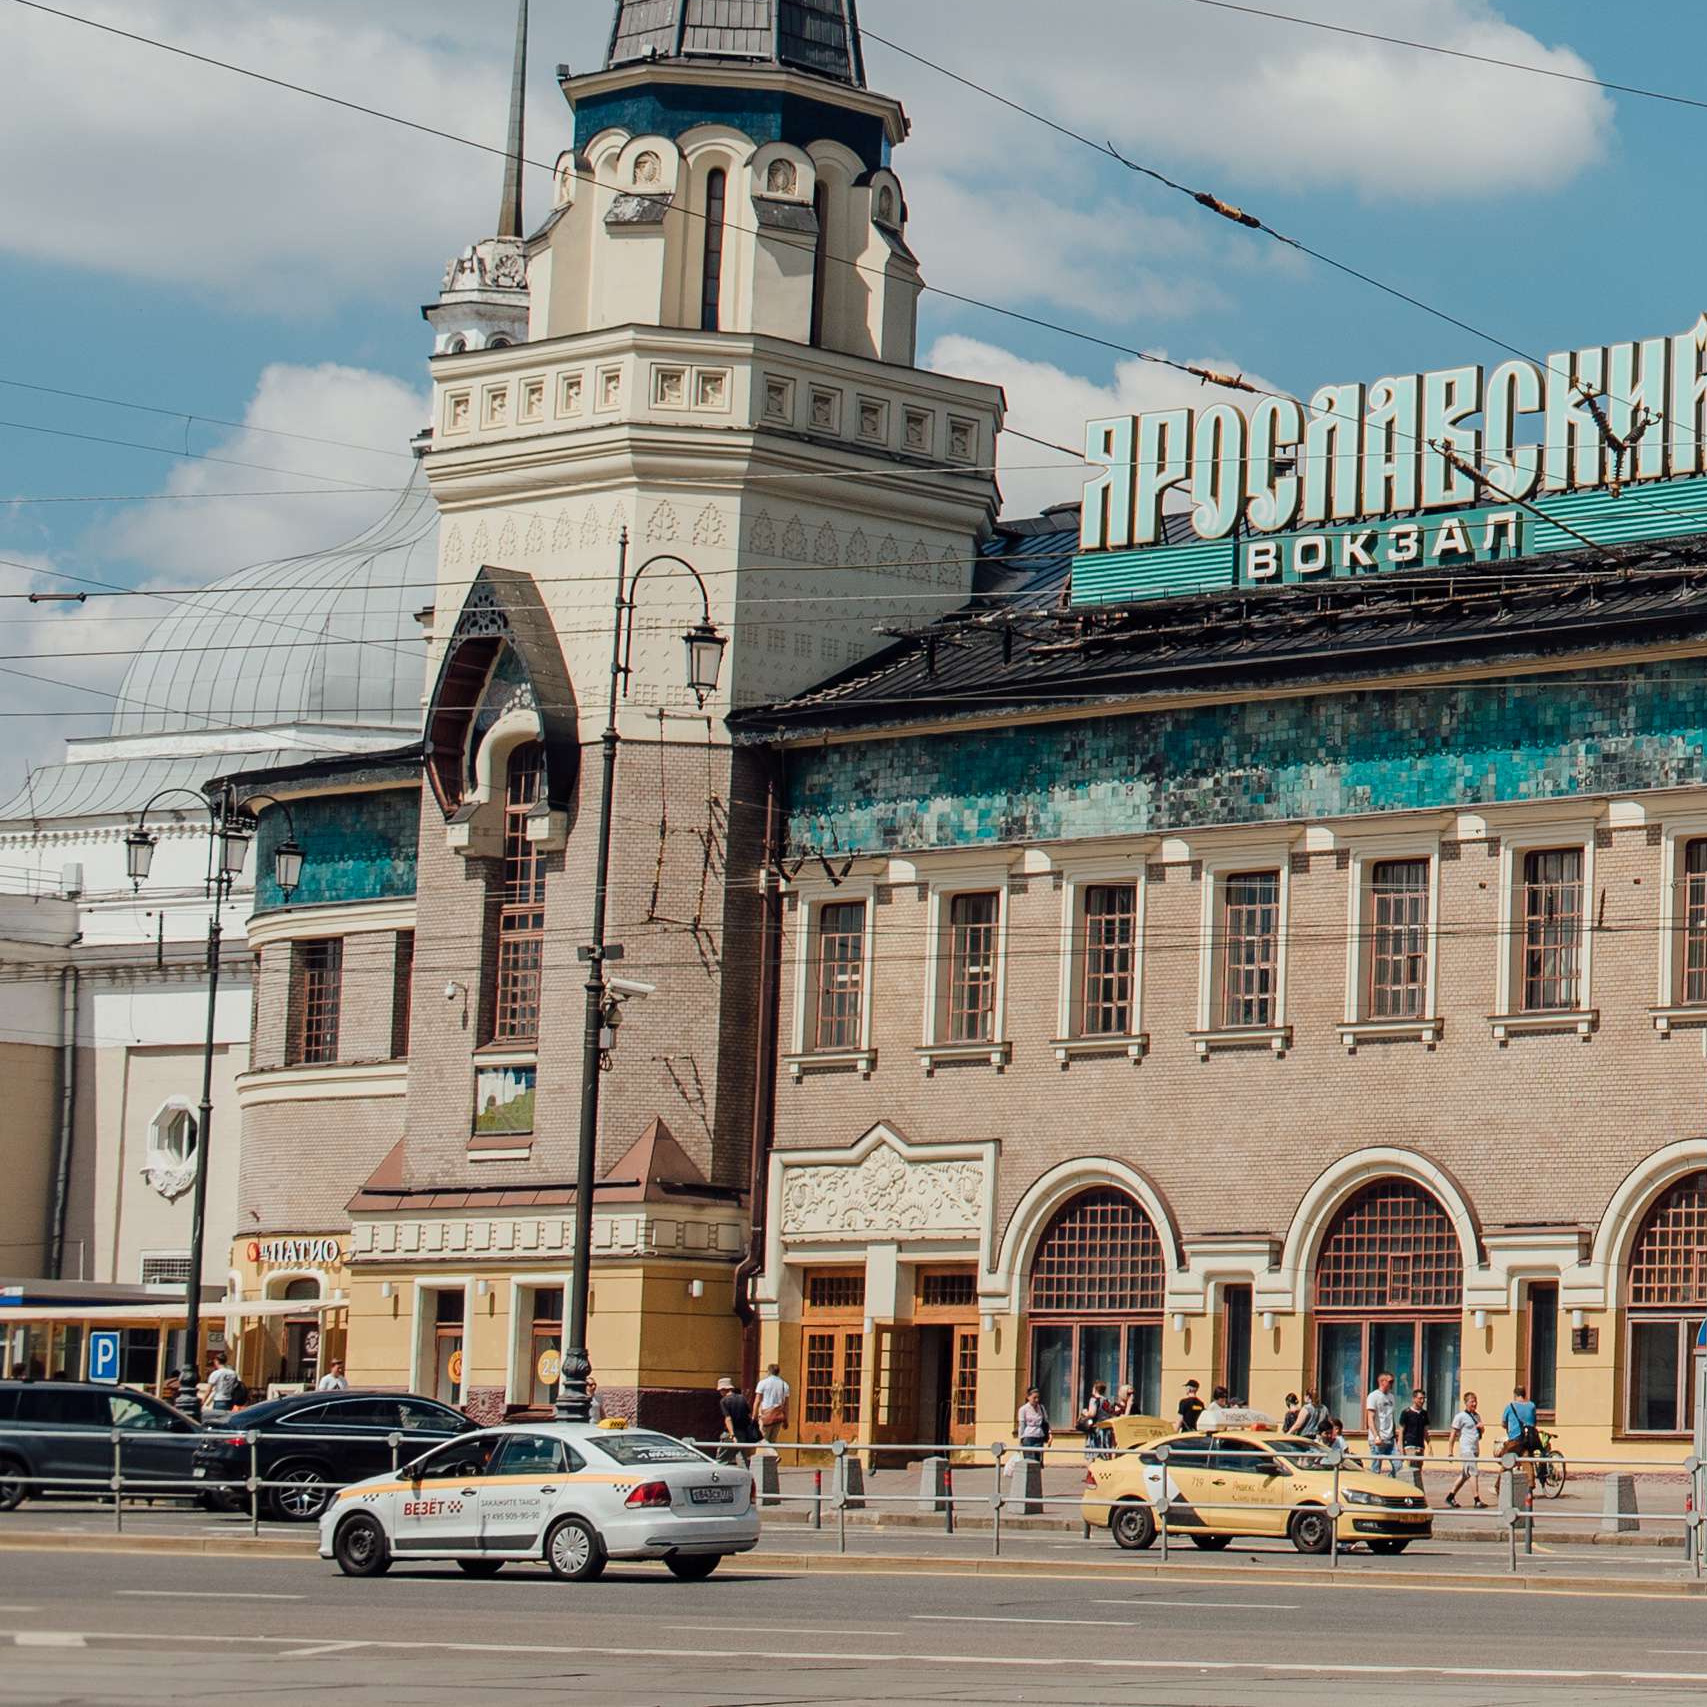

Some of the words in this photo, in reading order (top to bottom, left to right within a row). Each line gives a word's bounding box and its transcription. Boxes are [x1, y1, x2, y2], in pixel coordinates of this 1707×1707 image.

[1246, 510, 1523, 579] ВОКЗАЛ
[270, 1240, 340, 1262] ПАТИО
[97, 1338, 114, 1375] P
[541, 1359, 560, 1376] 24
[403, 1497, 445, 1516] ВЕЗЁТ
